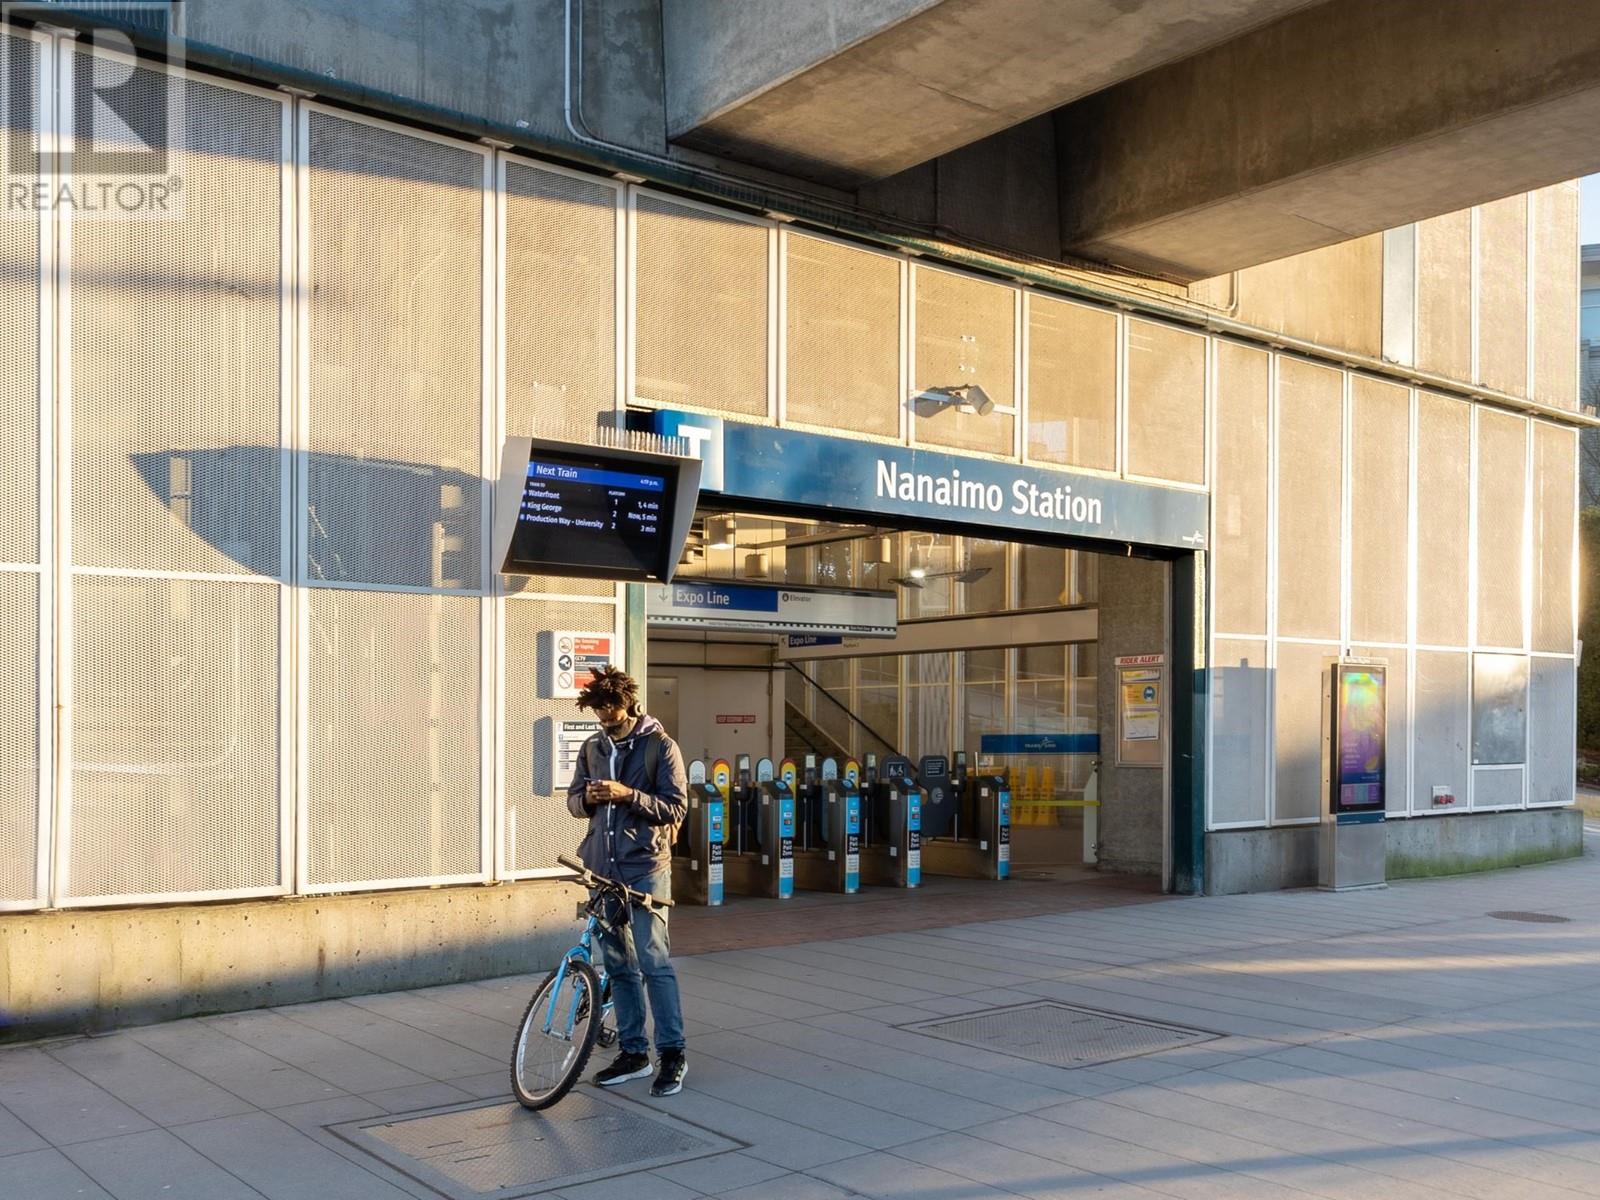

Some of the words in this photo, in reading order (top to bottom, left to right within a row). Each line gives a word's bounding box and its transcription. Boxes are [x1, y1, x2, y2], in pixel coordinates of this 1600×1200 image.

[536, 465, 556, 476] Next
[558, 467, 578, 478] Train
[528, 489, 560, 499] Waterfront
[876, 459, 1003, 512] Nanaimo
[1011, 479, 1102, 525] Station
[527, 501, 540, 511] King
[541, 503, 562, 513] George
[526, 514, 558, 523] Production
[558, 517, 571, 526] Way
[575, 518, 604, 529] University
[645, 525, 656, 533] min
[676, 589, 704, 605] Expo
[706, 591, 730, 605] Line
[790, 636, 803, 646] Expo
[804, 635, 817, 643] Line
[1120, 656, 1139, 664] RIDER
[1139, 655, 1160, 663] ALERT
